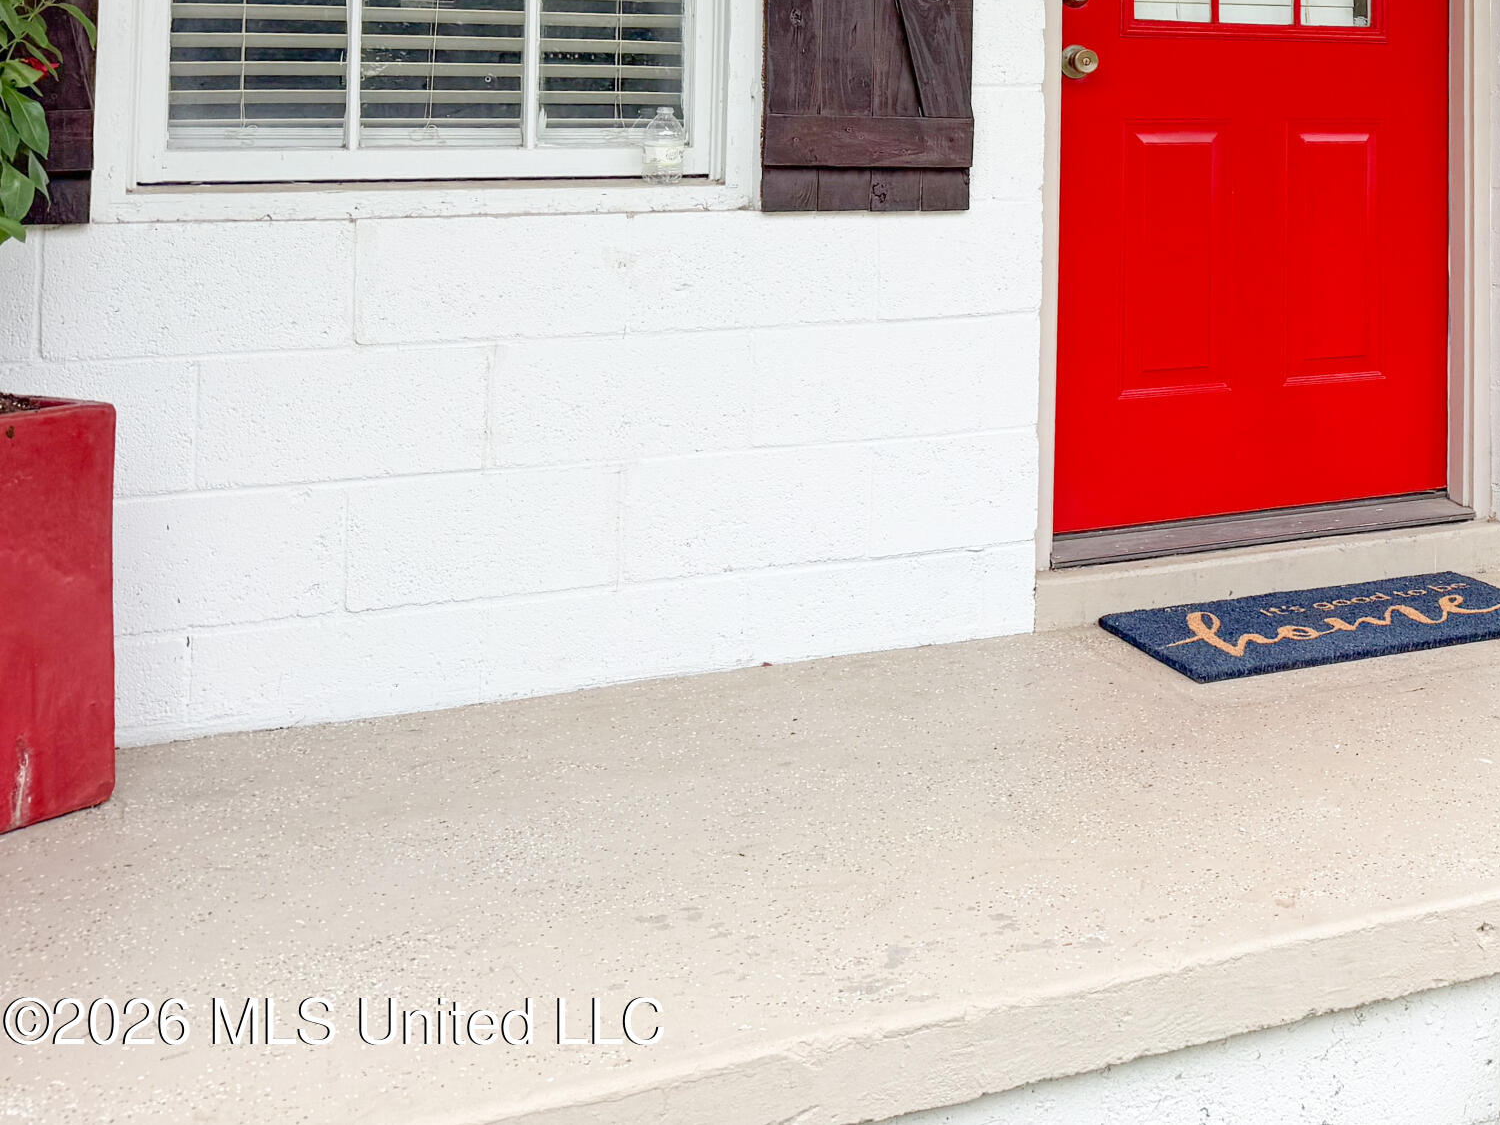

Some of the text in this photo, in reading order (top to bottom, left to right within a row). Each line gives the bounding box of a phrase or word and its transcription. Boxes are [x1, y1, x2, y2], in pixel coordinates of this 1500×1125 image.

[1260, 582, 1470, 617] It's good to be
